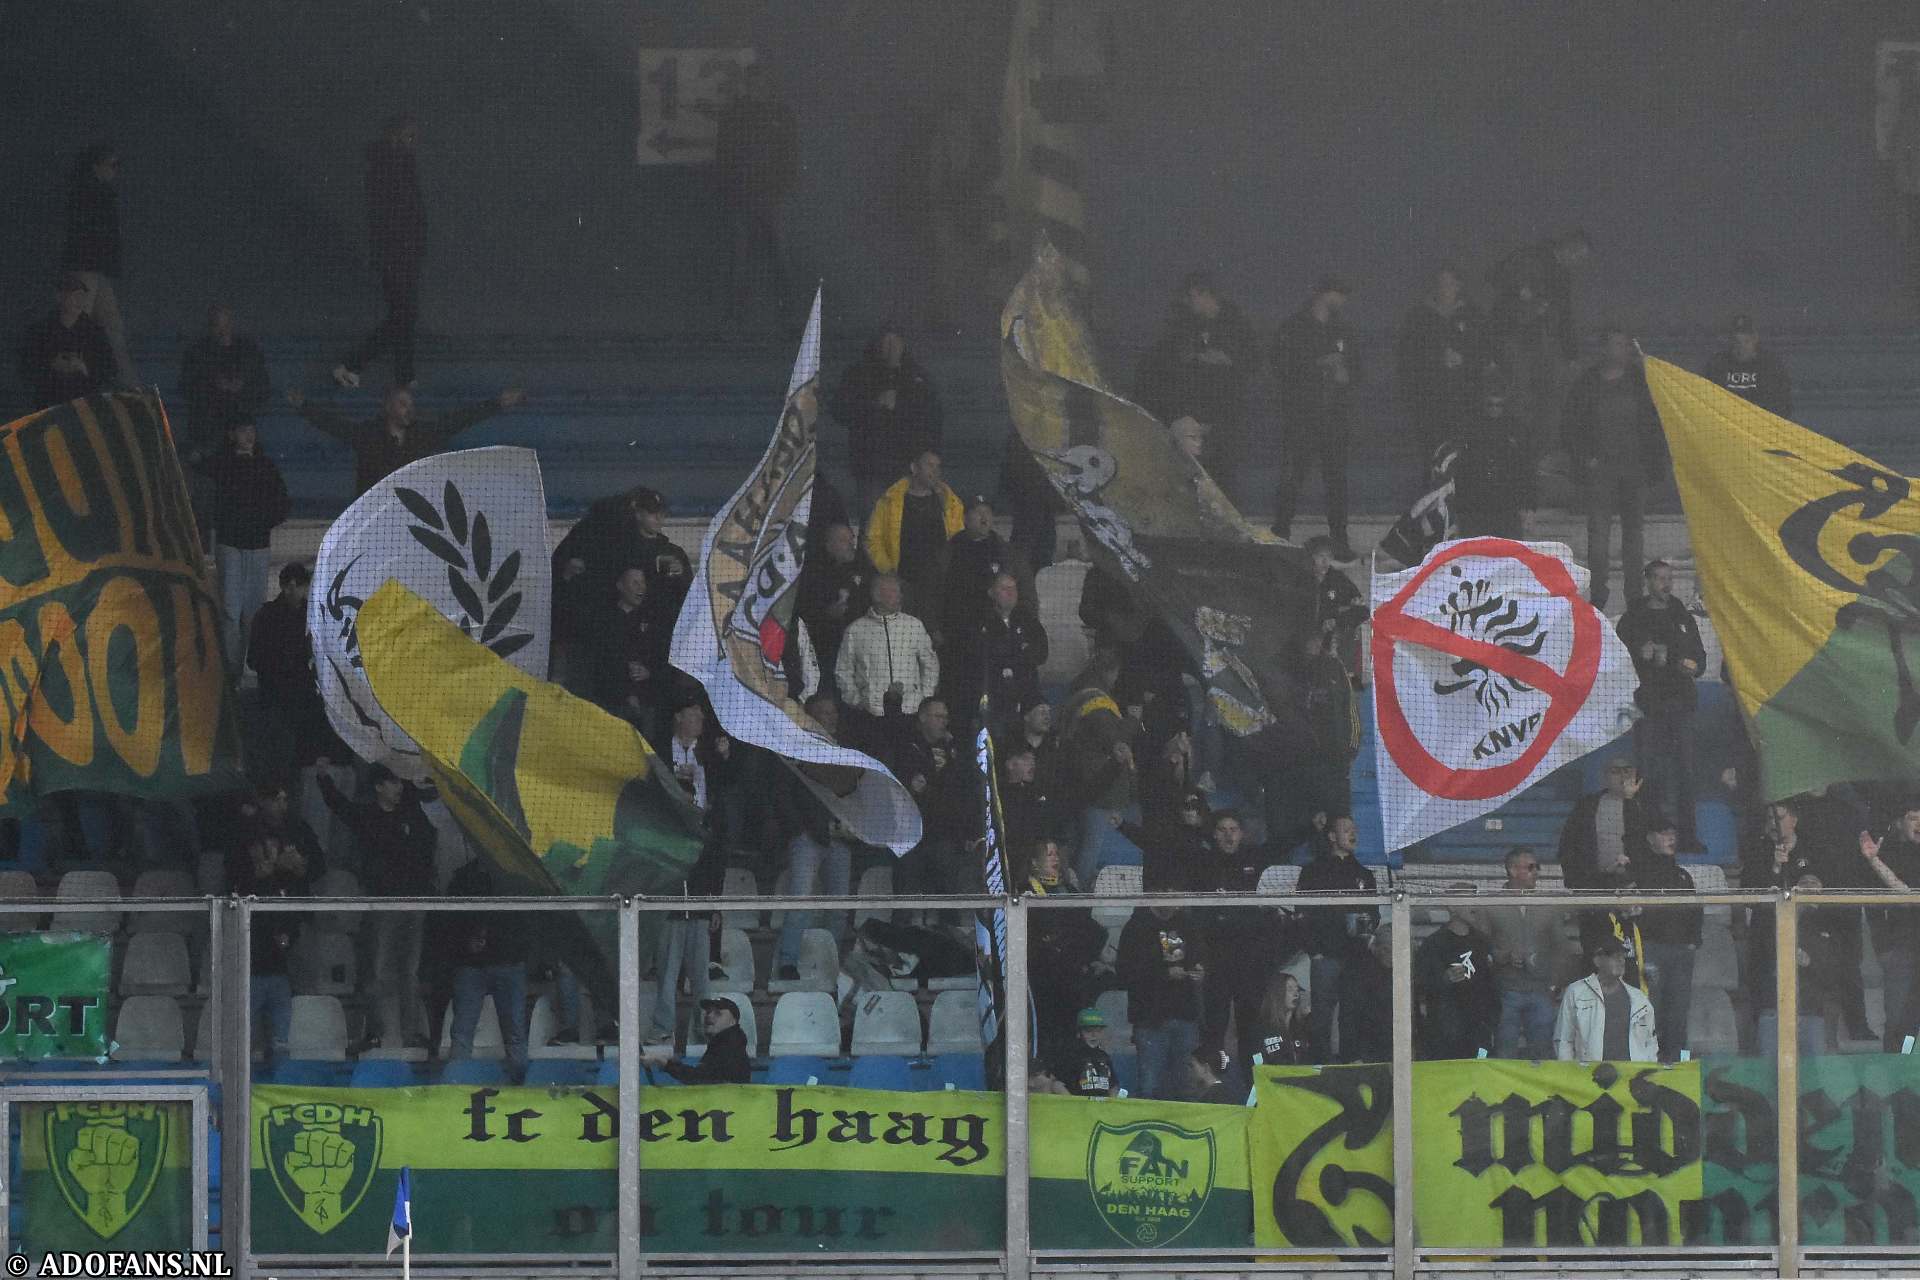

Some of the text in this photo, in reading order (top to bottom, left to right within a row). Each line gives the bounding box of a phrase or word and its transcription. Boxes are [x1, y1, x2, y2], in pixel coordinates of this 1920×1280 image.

[272, 1105, 372, 1127] FCDH
[462, 1087, 990, 1167] fc den haag
[1120, 1156, 1189, 1179] FAN
[1121, 1175, 1180, 1187] SUPPORT
[700, 1188, 898, 1240] tour
[1106, 1203, 1191, 1218] DEN HAAG
